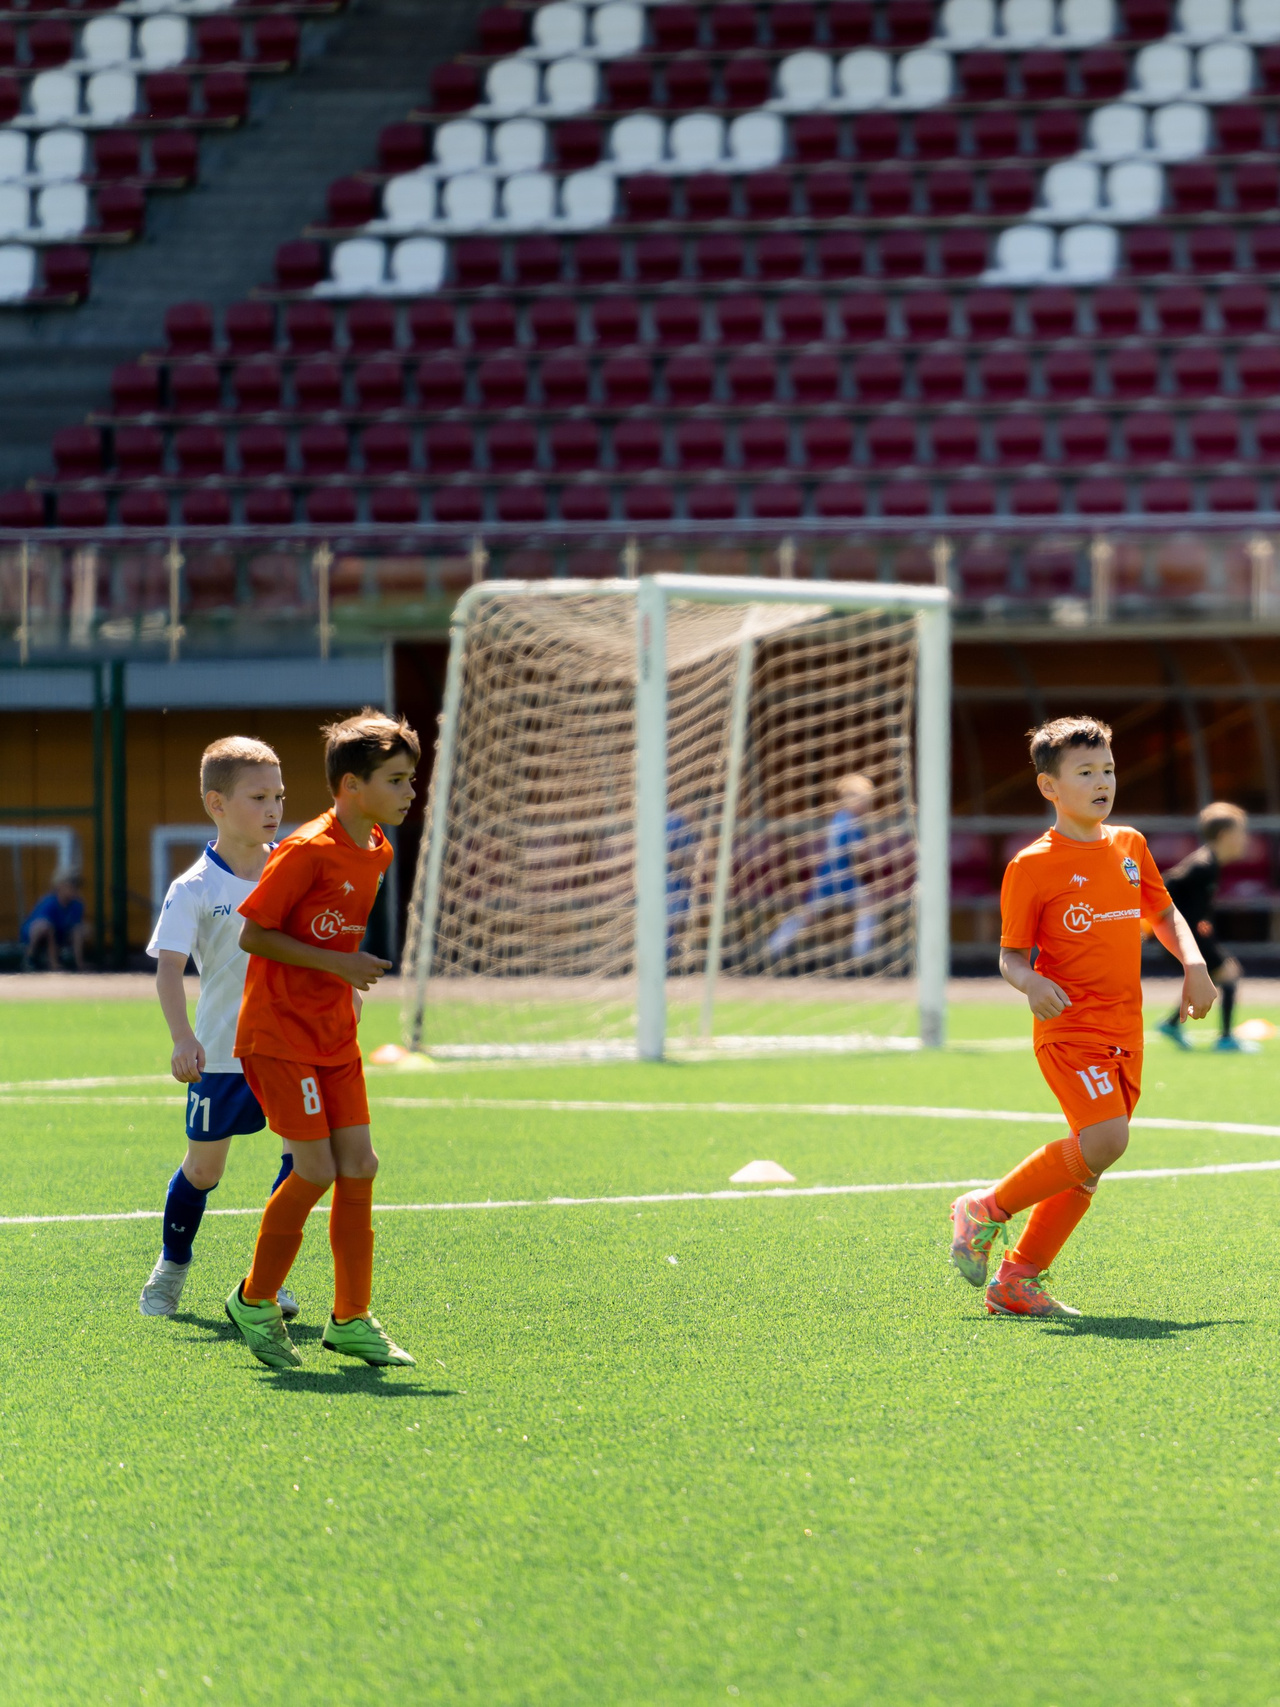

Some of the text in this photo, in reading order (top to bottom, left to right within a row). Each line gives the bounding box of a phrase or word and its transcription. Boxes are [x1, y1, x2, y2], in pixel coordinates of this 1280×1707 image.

[212, 903, 232, 918] FN
[300, 1076, 321, 1116] 8
[1075, 1065, 1114, 1101] 15
[188, 1090, 211, 1133] 71
